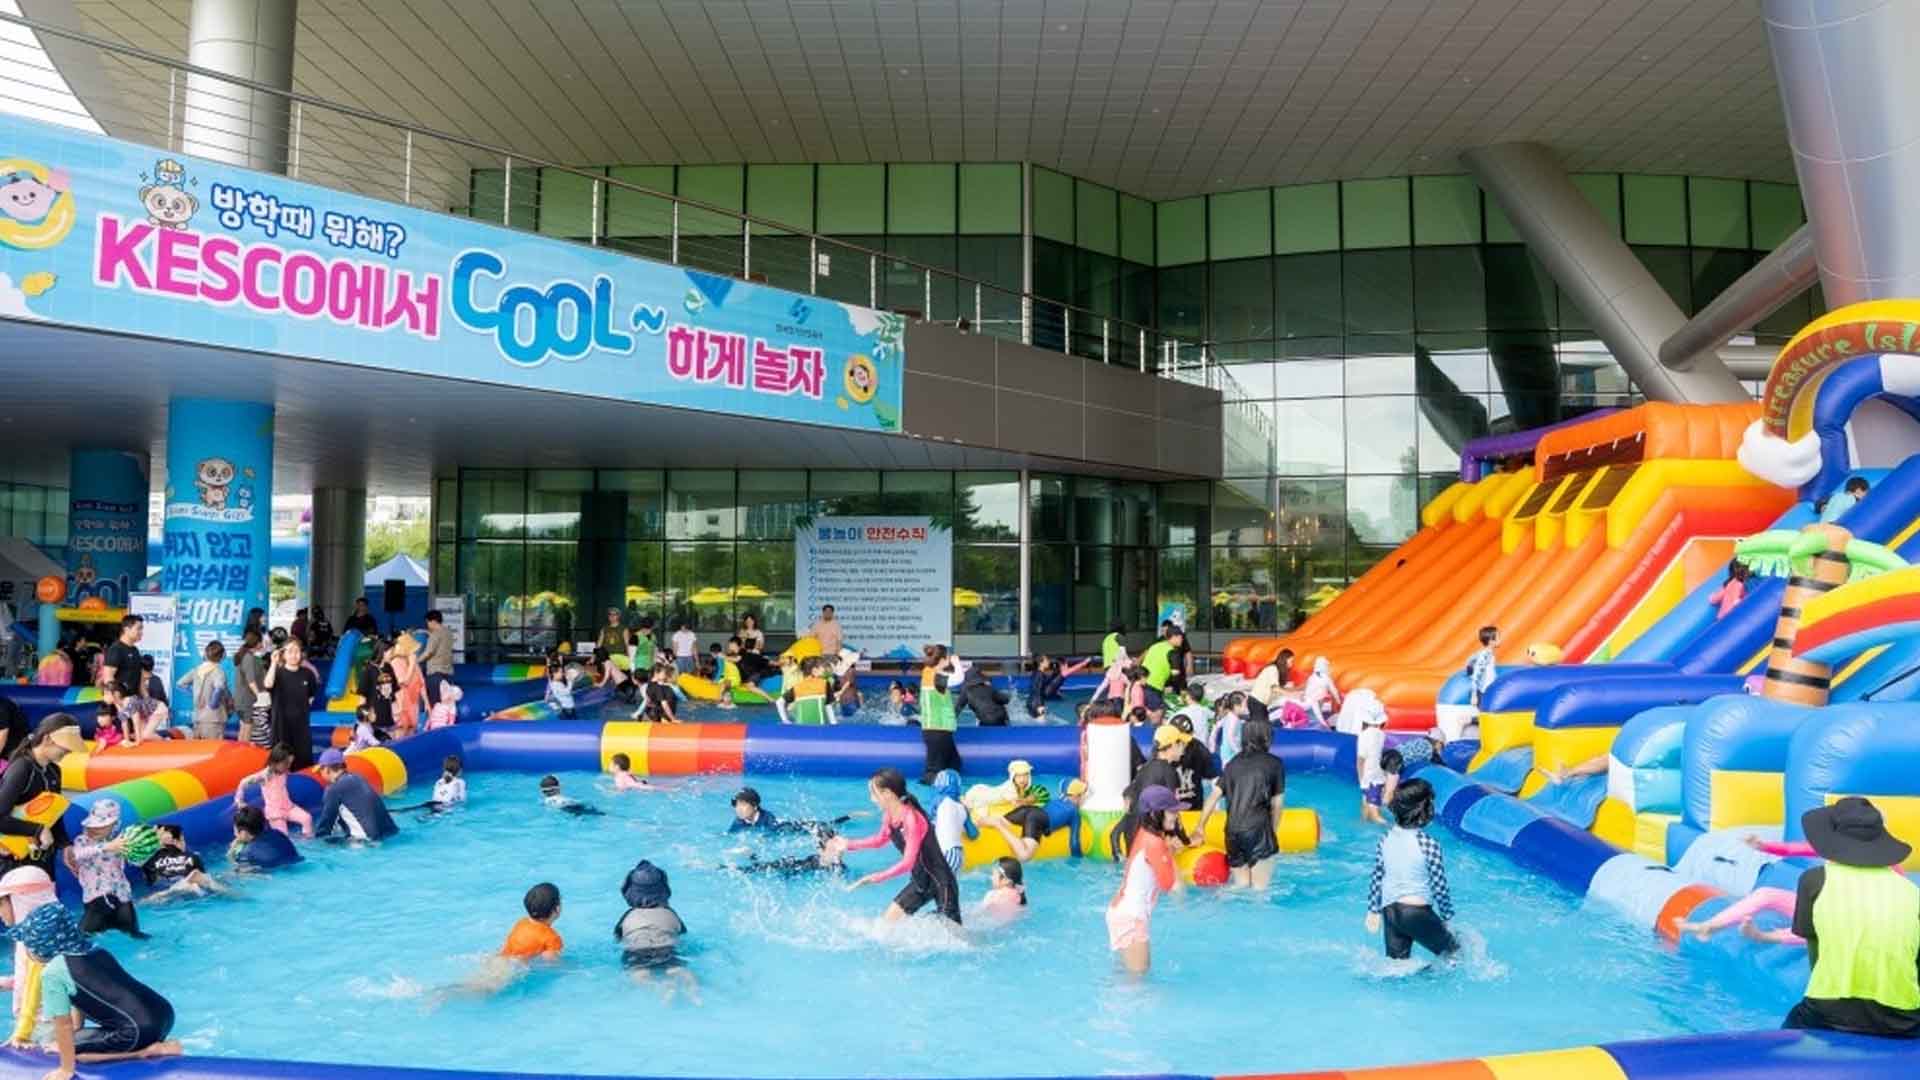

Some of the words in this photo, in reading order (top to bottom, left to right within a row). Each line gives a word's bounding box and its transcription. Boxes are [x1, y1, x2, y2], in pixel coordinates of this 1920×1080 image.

[211, 185, 313, 237] 방학때
[323, 212, 406, 258] 뭐해?
[97, 215, 441, 337] KESCO에서
[667, 328, 746, 386] 하게
[754, 341, 826, 397] 놀자
[206, 531, 252, 558] 않고
